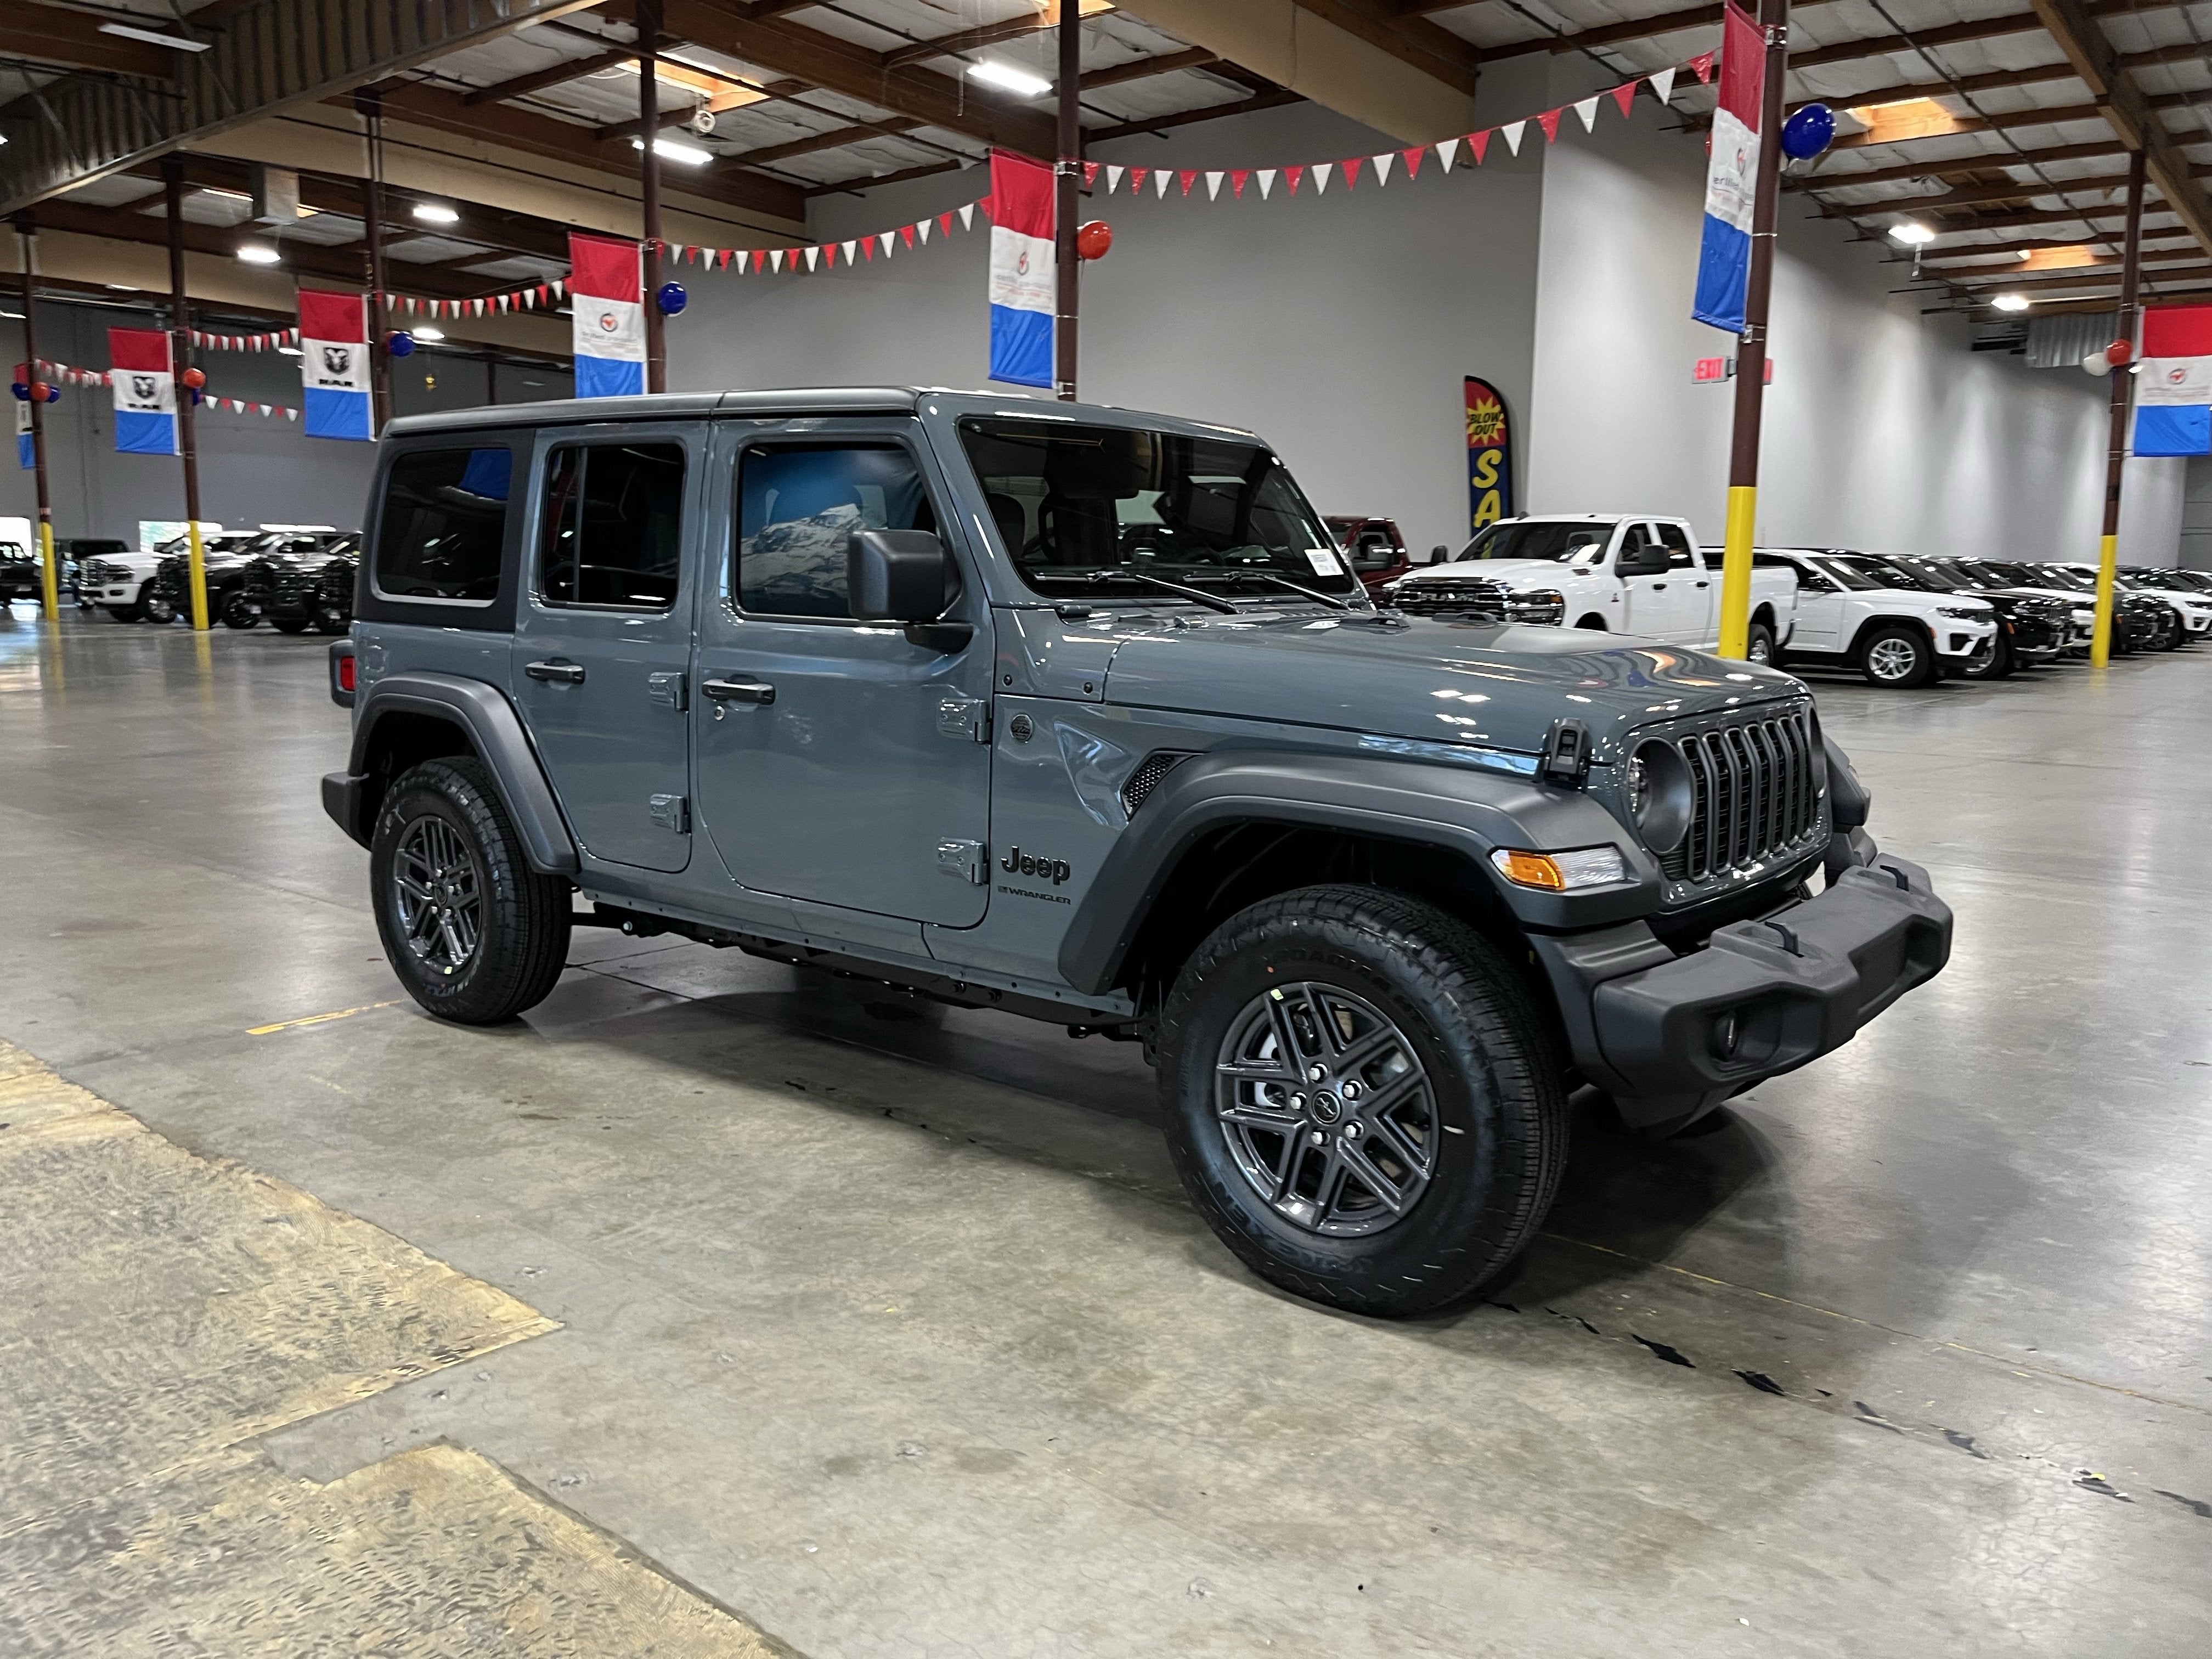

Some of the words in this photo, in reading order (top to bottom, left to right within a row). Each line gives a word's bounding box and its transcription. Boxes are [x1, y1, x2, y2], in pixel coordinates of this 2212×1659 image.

[1470, 413, 1500, 424] BLOW
[1474, 423, 1497, 435] OUT
[1001, 845, 1070, 885] Jeep
[1008, 887, 1071, 905] WRANGLER
